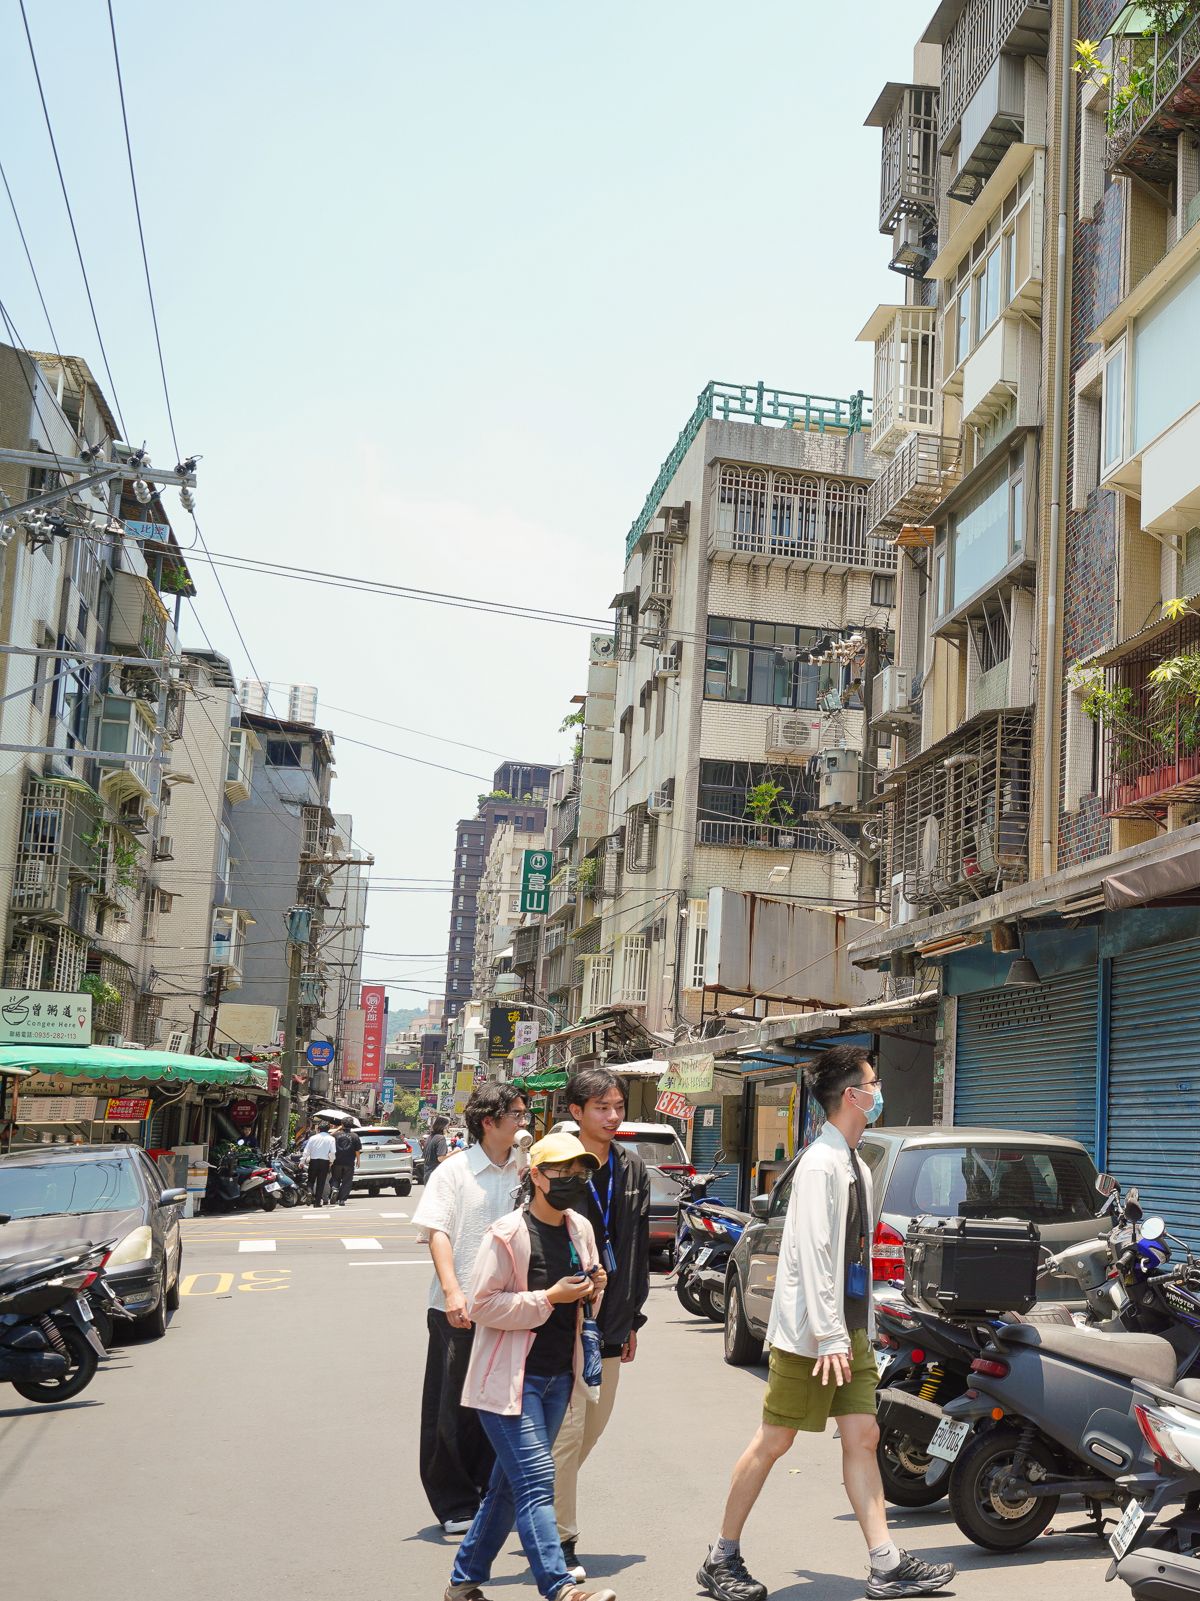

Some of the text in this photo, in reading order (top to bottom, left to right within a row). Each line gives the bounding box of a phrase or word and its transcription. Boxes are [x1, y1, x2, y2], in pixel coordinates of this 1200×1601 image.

[526, 872, 547, 911] 富山
[26, 1020, 55, 1028] Congee
[1166, 1292, 1195, 1310] MONSTER
